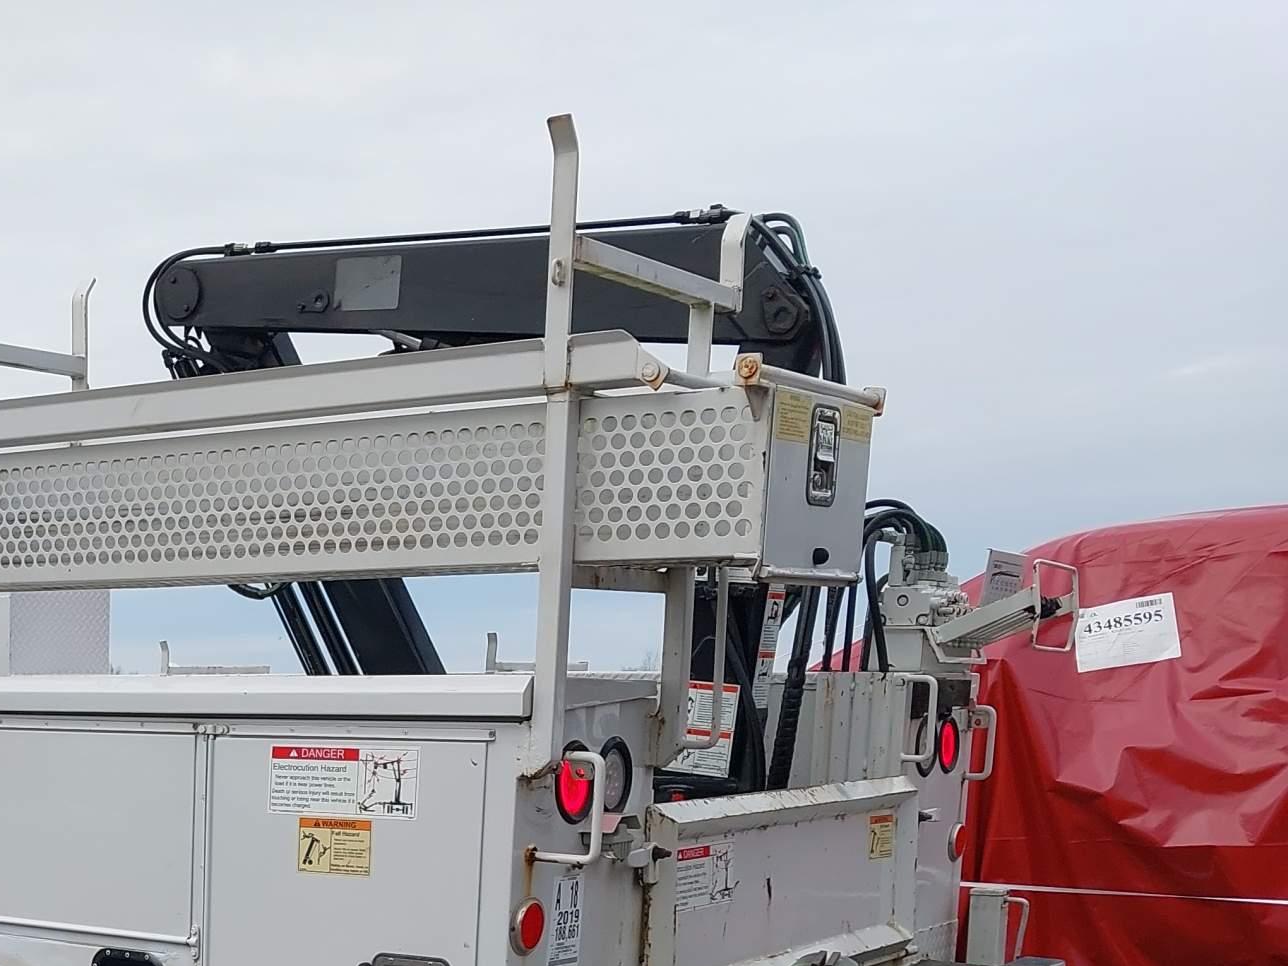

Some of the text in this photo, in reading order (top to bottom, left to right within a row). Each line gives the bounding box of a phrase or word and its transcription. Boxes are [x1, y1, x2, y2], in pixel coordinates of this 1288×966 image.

[1083, 609, 1164, 635] 43485595
[301, 748, 345, 759] DANGER
[272, 762, 348, 773] Electrocution Hazard
[321, 820, 357, 829] WARNING
[555, 880, 579, 911] A 18
[556, 909, 580, 926] 2019
